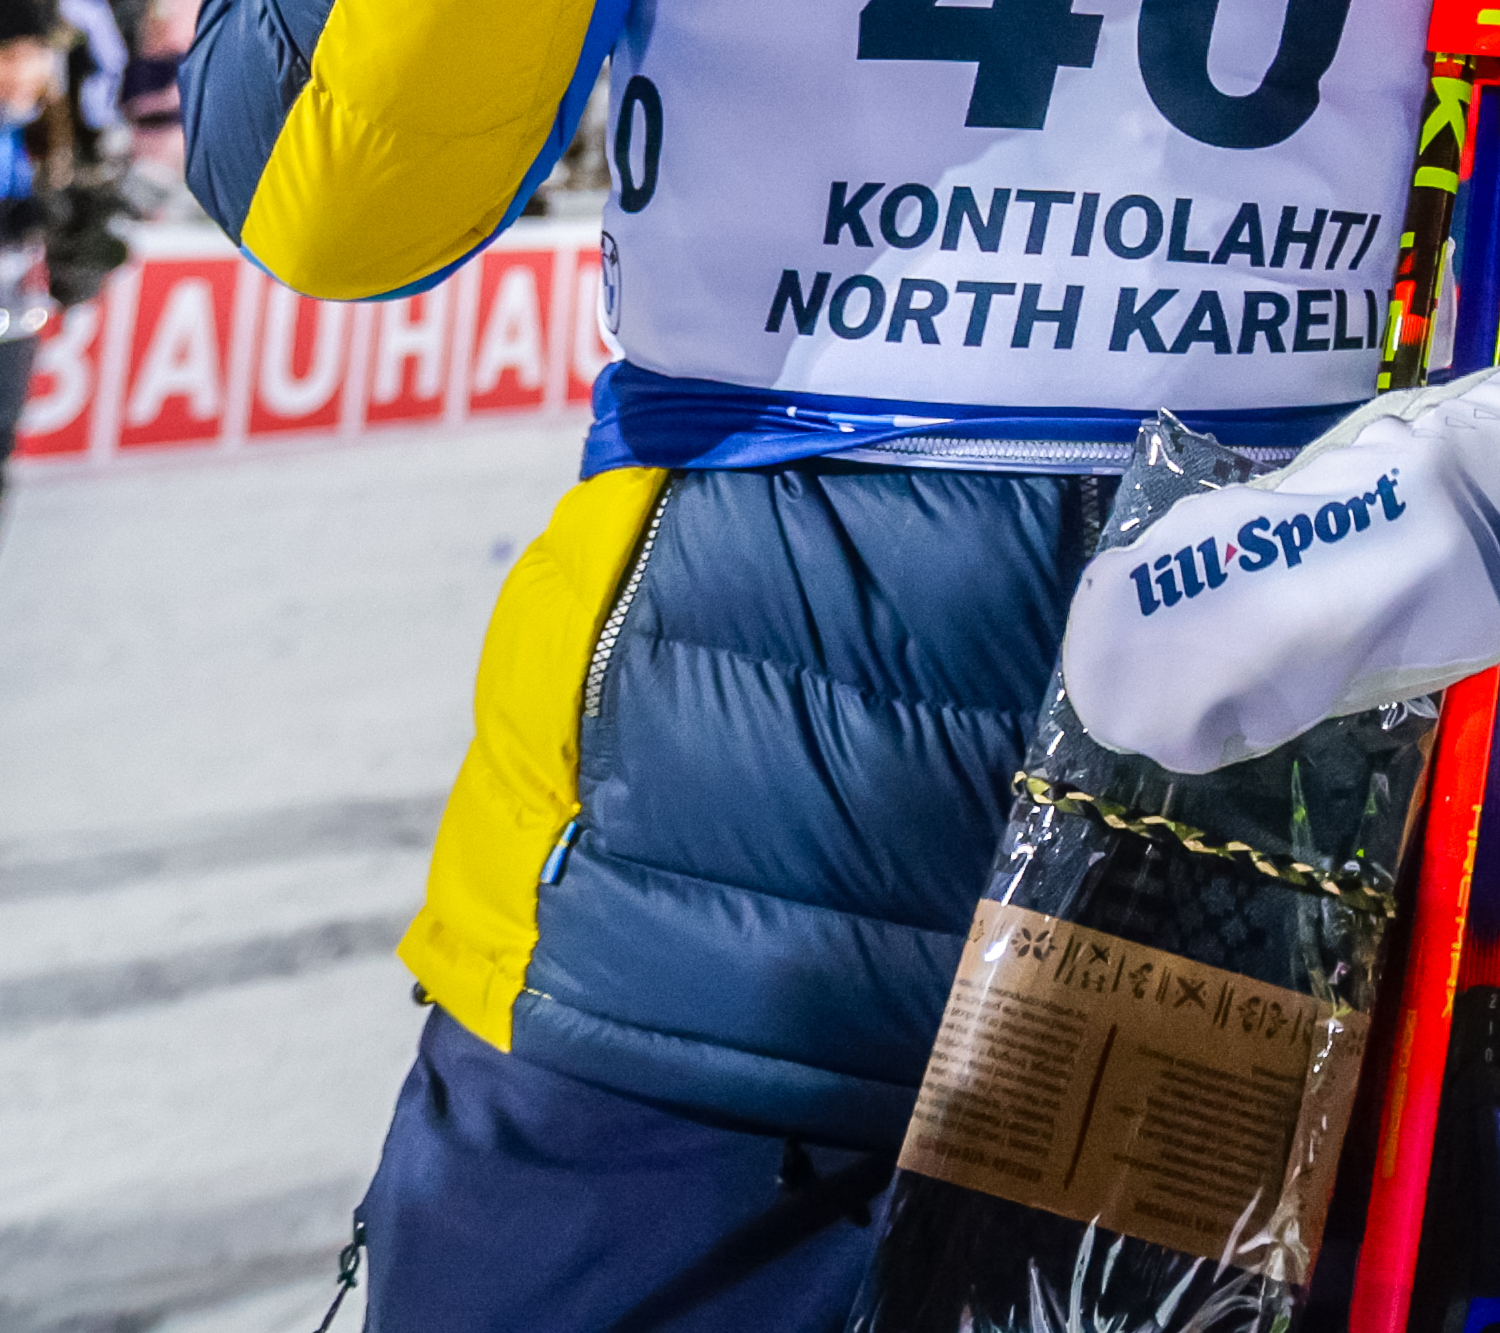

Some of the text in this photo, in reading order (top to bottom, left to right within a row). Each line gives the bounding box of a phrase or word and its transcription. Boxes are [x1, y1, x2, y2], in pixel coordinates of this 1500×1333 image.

[822, 180, 1383, 273] KONTIOLAHTI
[764, 269, 1392, 356] NORTH KARELI
